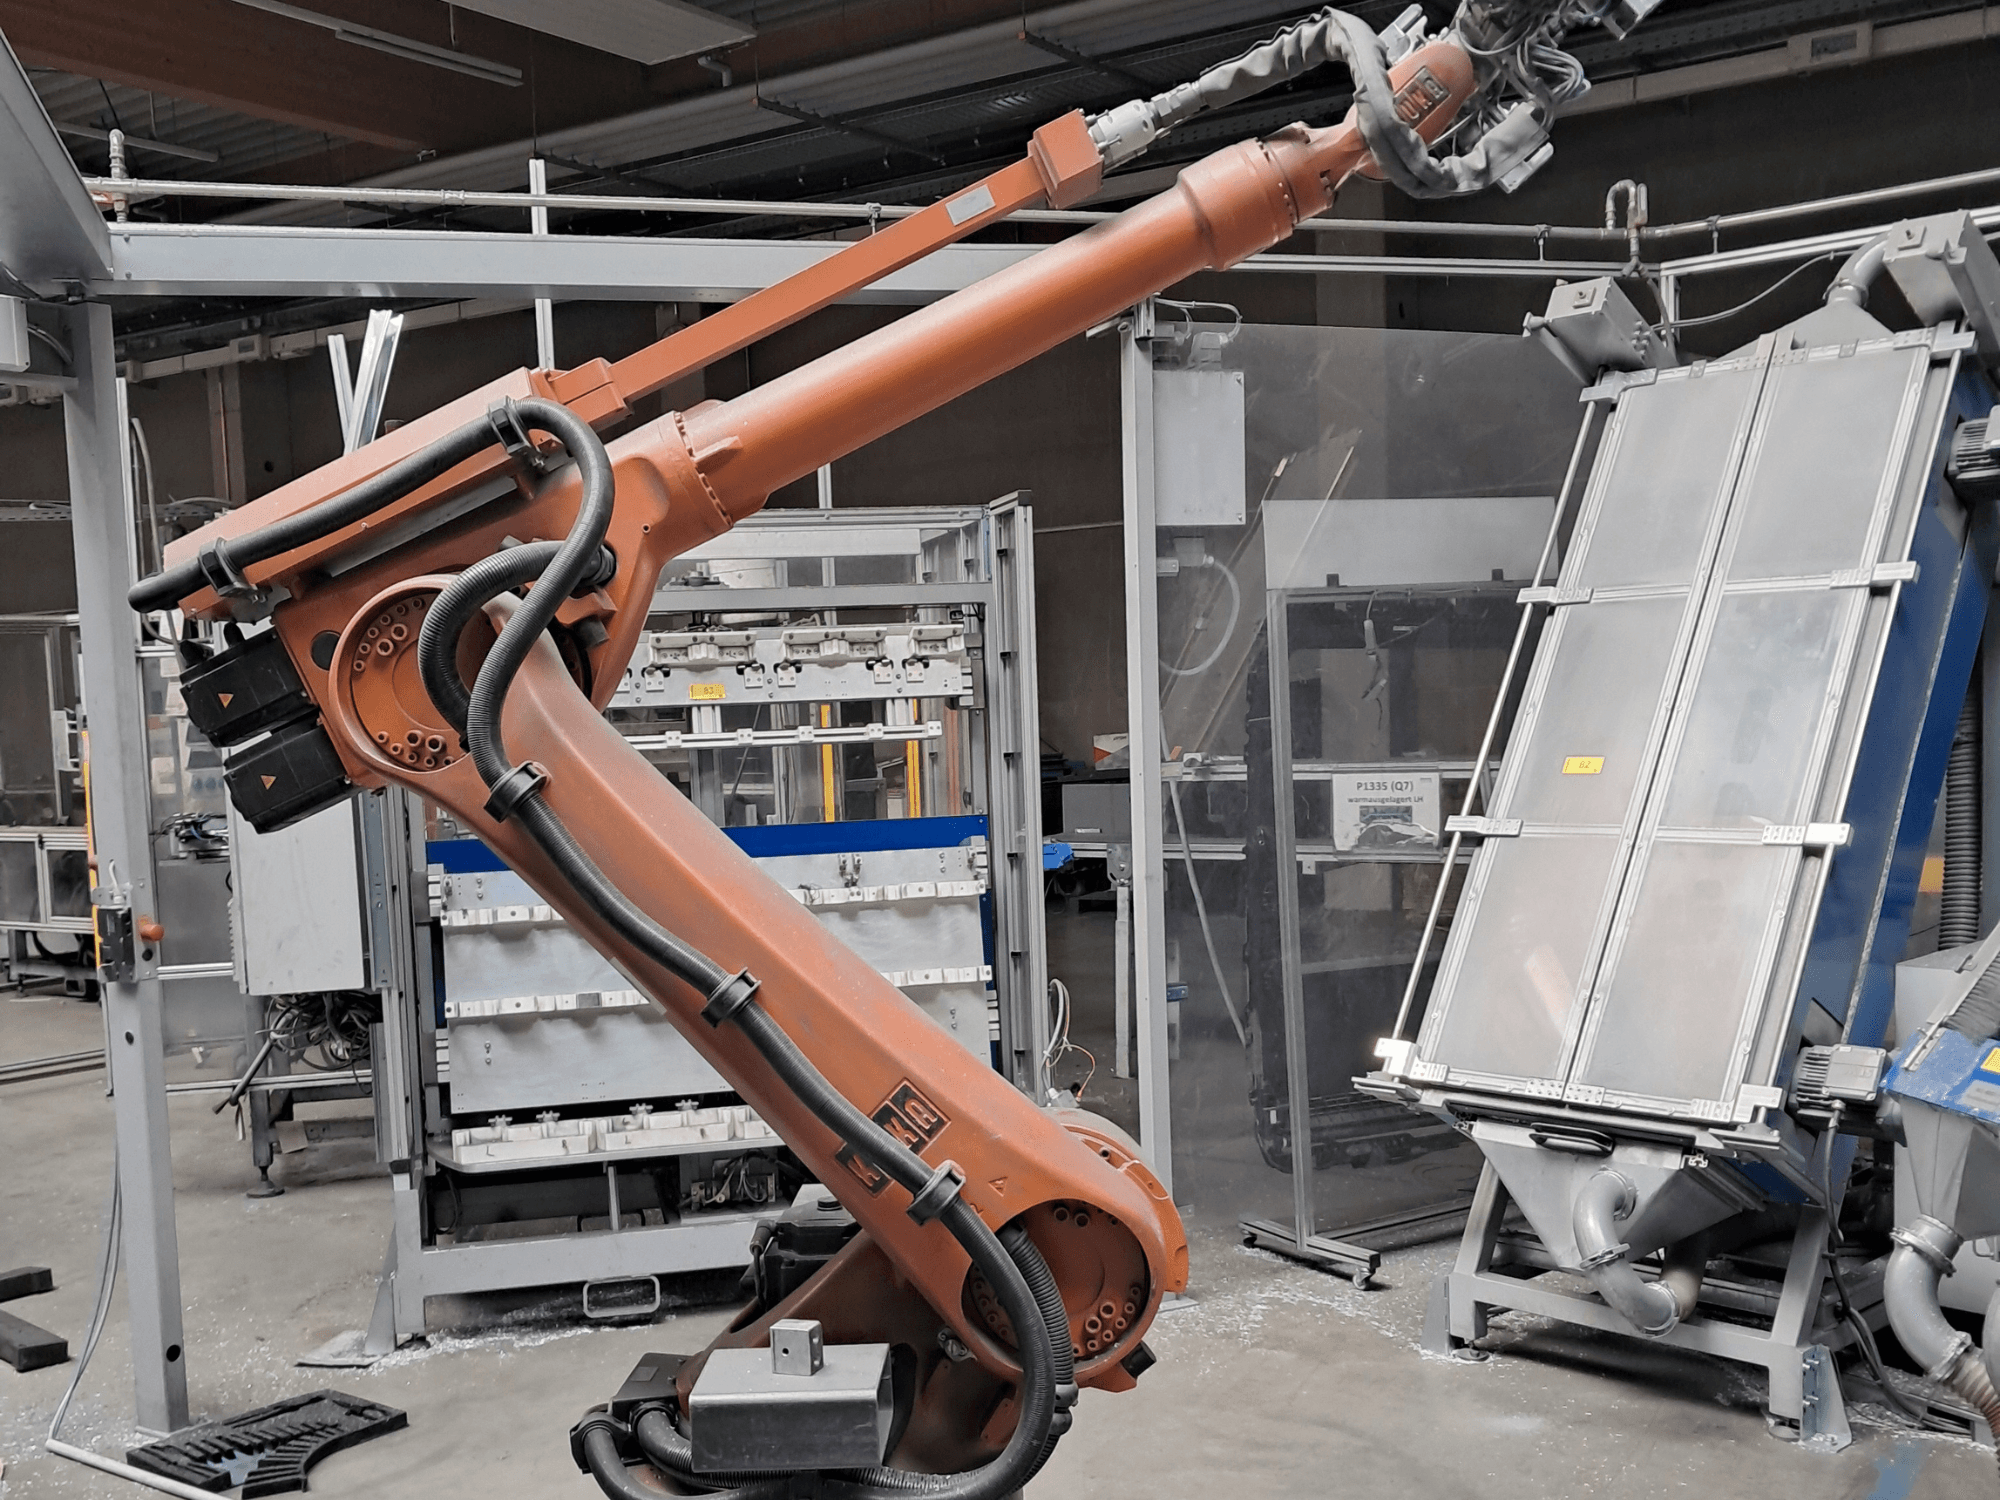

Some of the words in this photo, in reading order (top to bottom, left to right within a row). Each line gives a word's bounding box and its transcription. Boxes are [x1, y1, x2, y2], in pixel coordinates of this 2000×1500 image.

[1356, 781, 1388, 791] P1335
[1390, 780, 1414, 793] (Q7)
[846, 1098, 940, 1188] KKA
